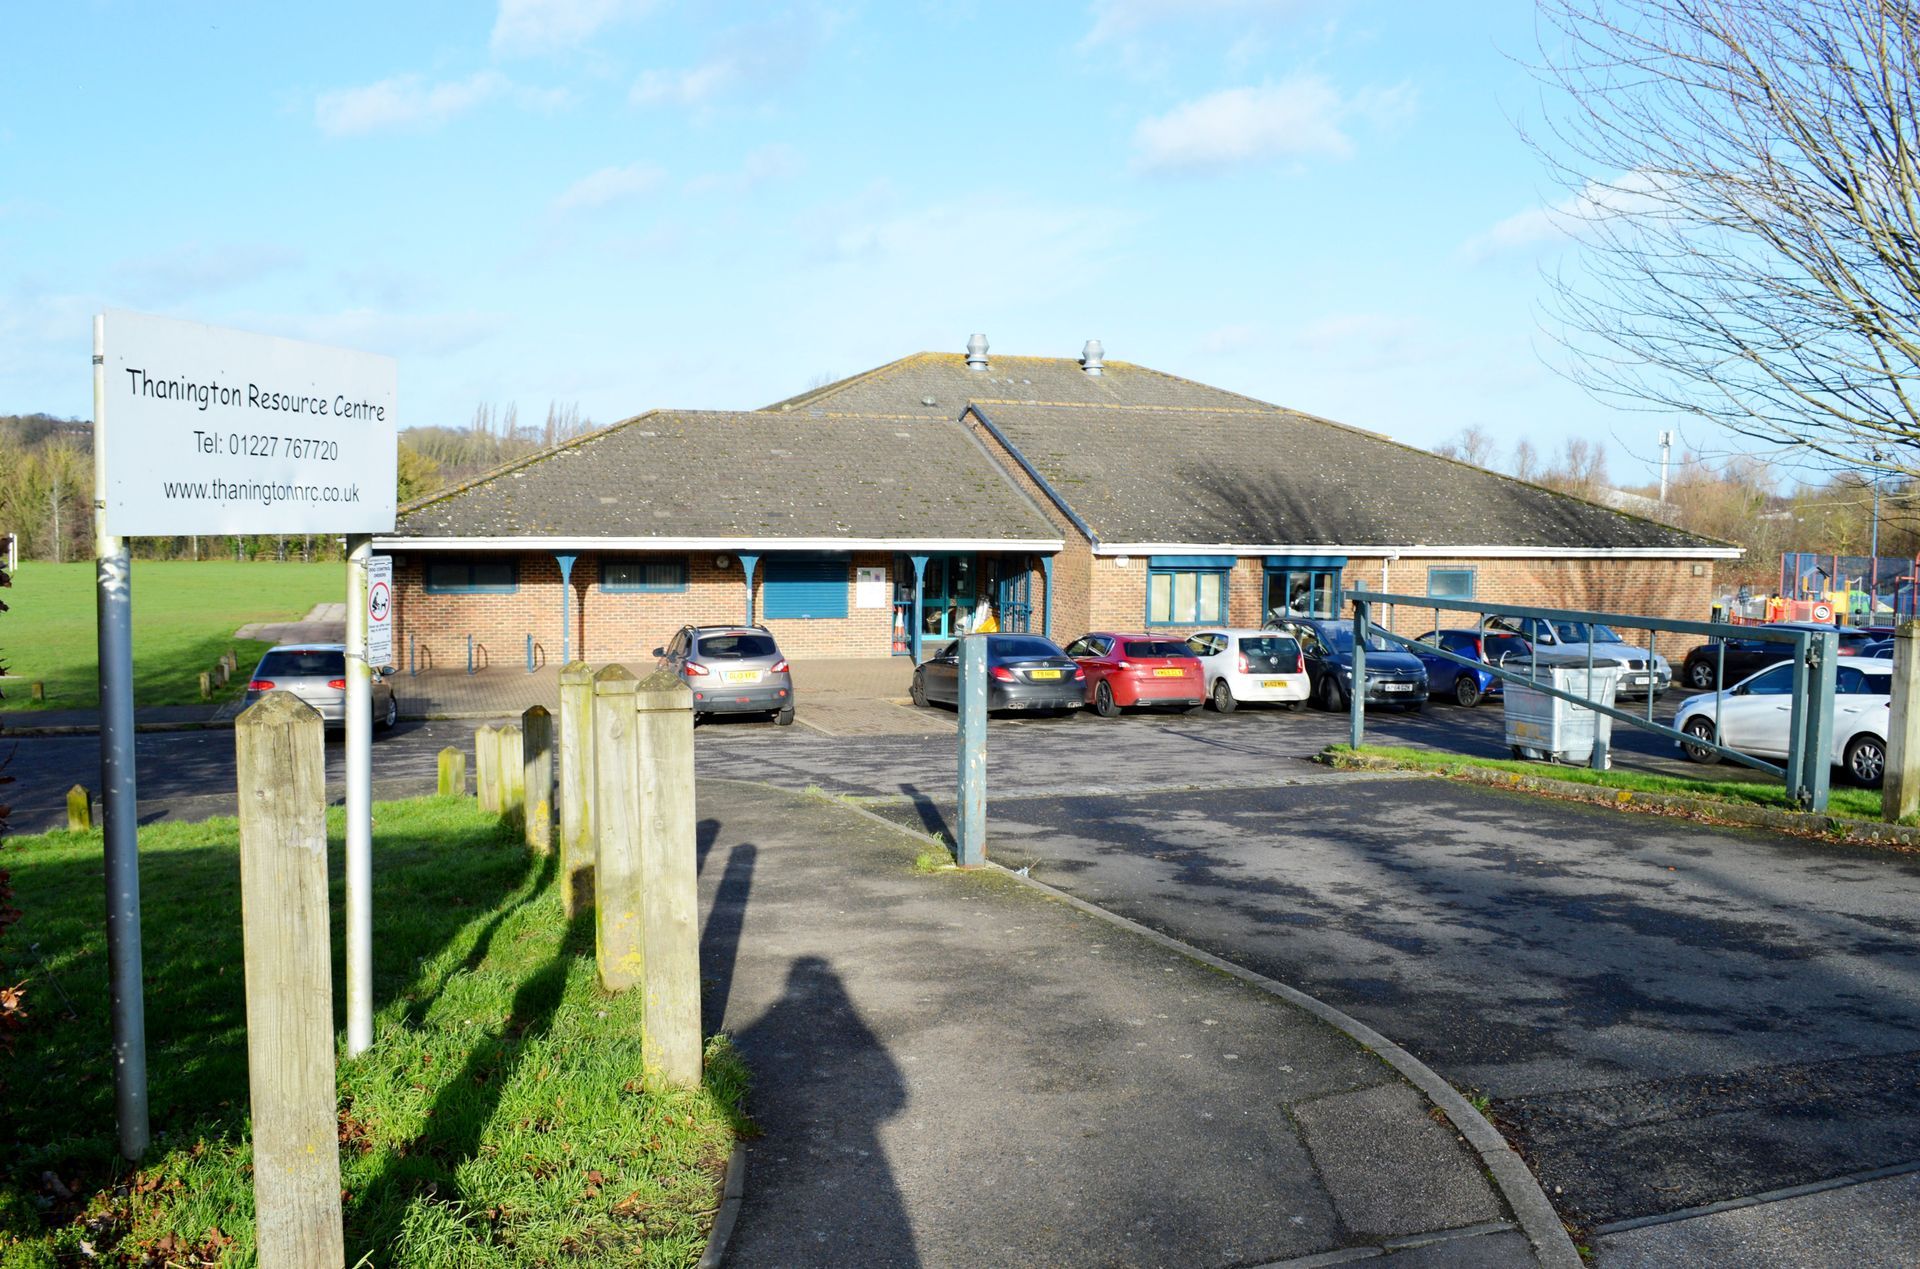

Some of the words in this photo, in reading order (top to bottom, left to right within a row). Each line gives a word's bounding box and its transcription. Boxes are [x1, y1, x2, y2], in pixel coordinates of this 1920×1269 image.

[125, 368, 242, 411] Thanington
[249, 384, 328, 416] Resource
[334, 395, 385, 422] Centre
[193, 431, 223, 454] Tel:
[229, 434, 278, 457] 01227
[284, 438, 338, 461] 767720
[164, 478, 360, 506] www.thaningtonnrc.co.uk
